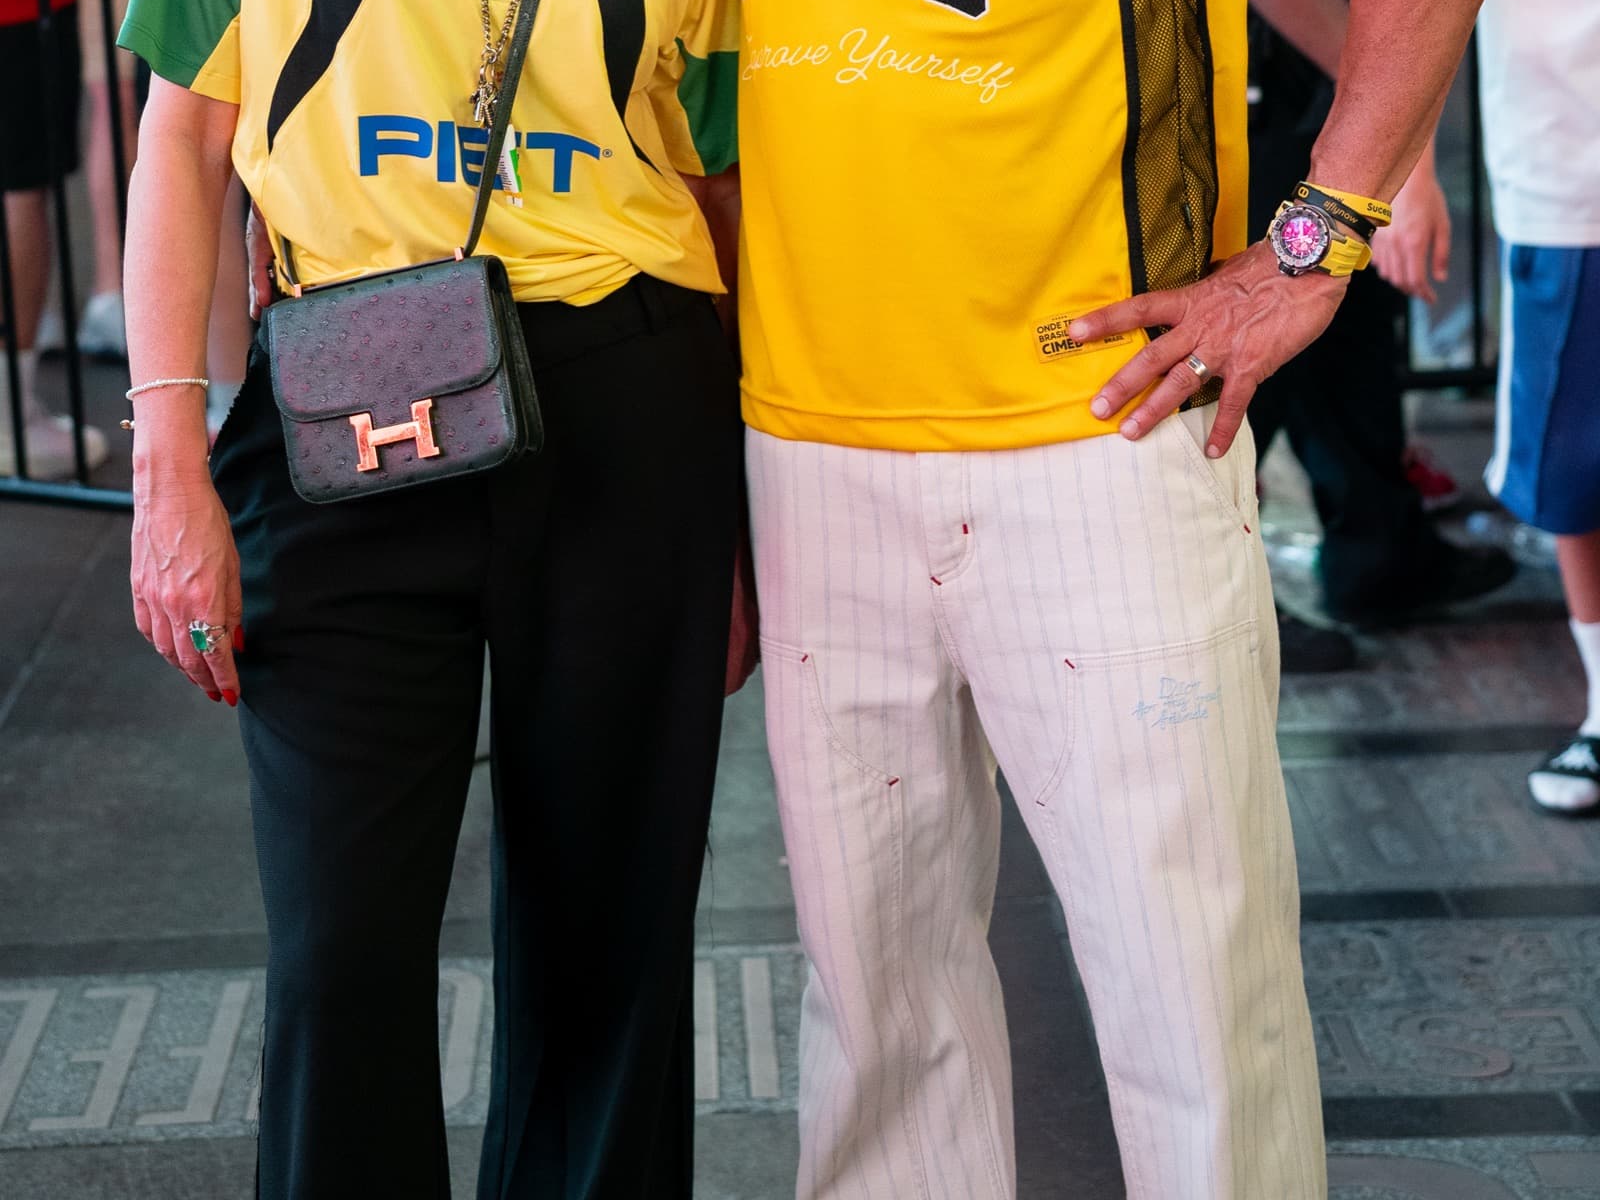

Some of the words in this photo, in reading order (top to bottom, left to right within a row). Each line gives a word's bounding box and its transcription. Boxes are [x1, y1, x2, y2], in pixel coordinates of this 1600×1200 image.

[742, 35, 832, 81] rove
[835, 28, 1015, 104] Yourself
[1367, 202, 1391, 217] Suces
[1037, 321, 1062, 334] ONDE
[1039, 330, 1070, 342] BRASIL
